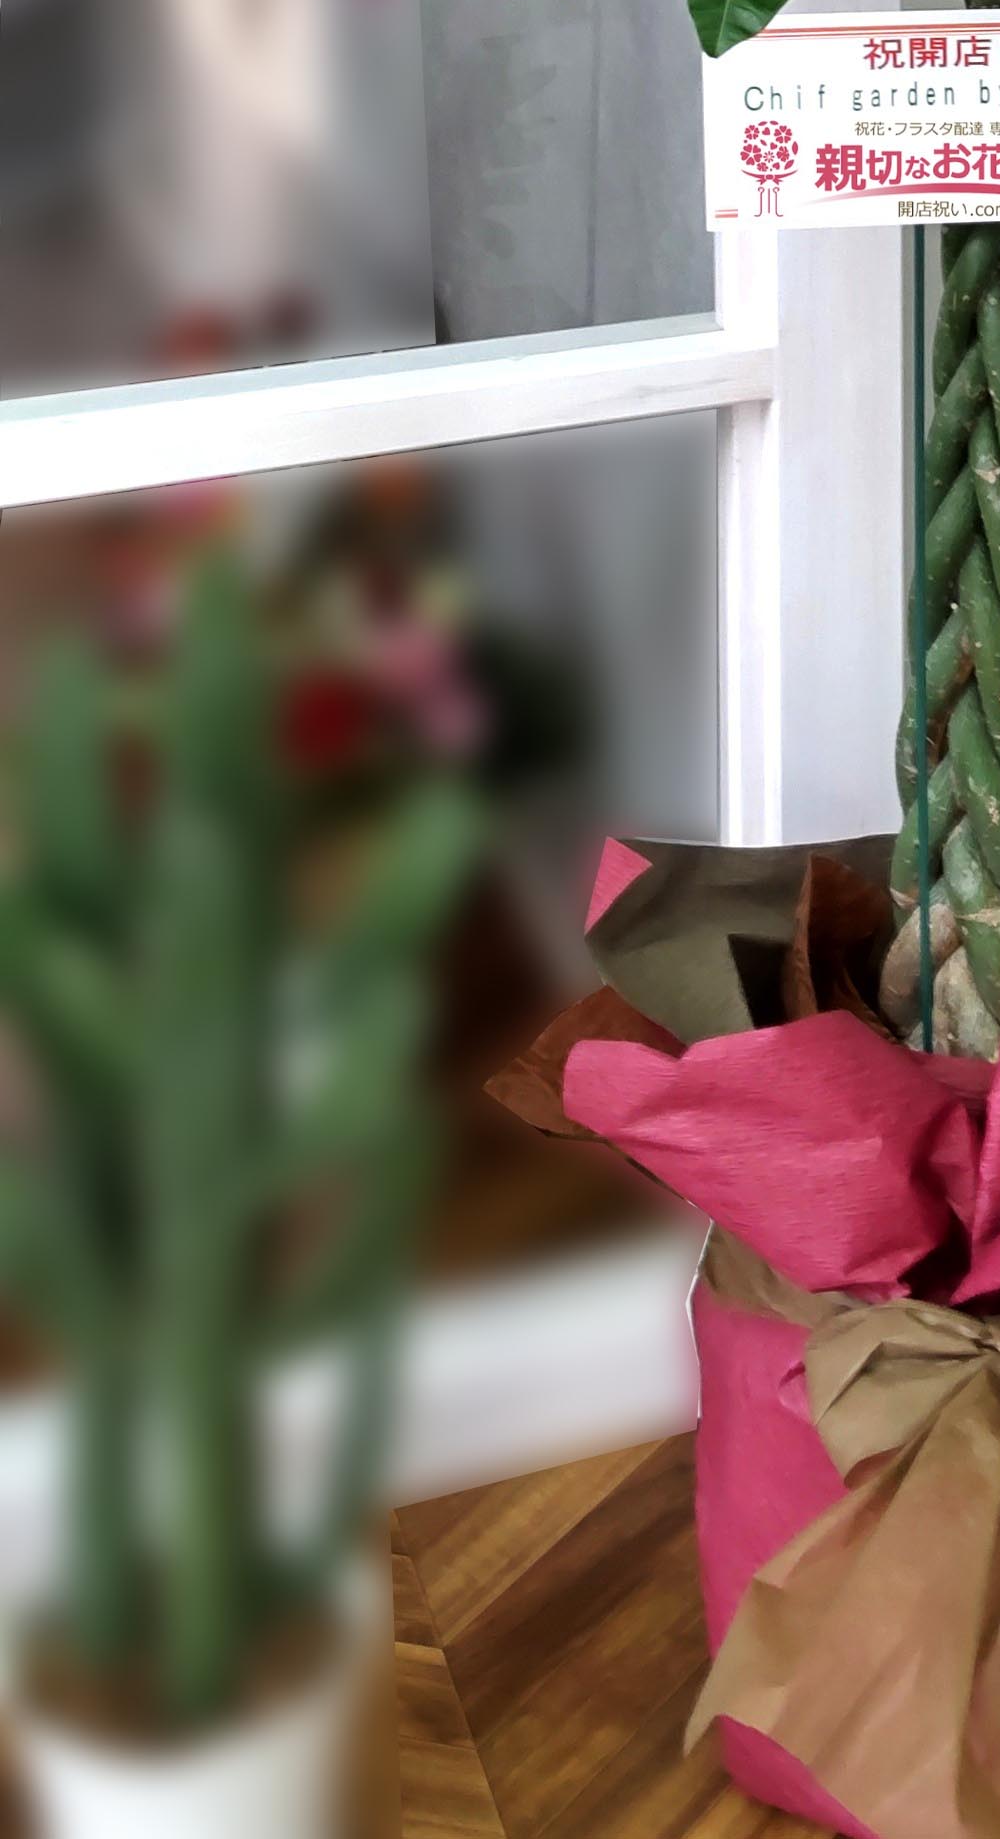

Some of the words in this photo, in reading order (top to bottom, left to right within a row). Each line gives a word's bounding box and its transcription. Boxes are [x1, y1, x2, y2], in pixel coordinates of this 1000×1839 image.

[863, 36, 992, 70] 祝開店
[853, 81, 955, 111] garden
